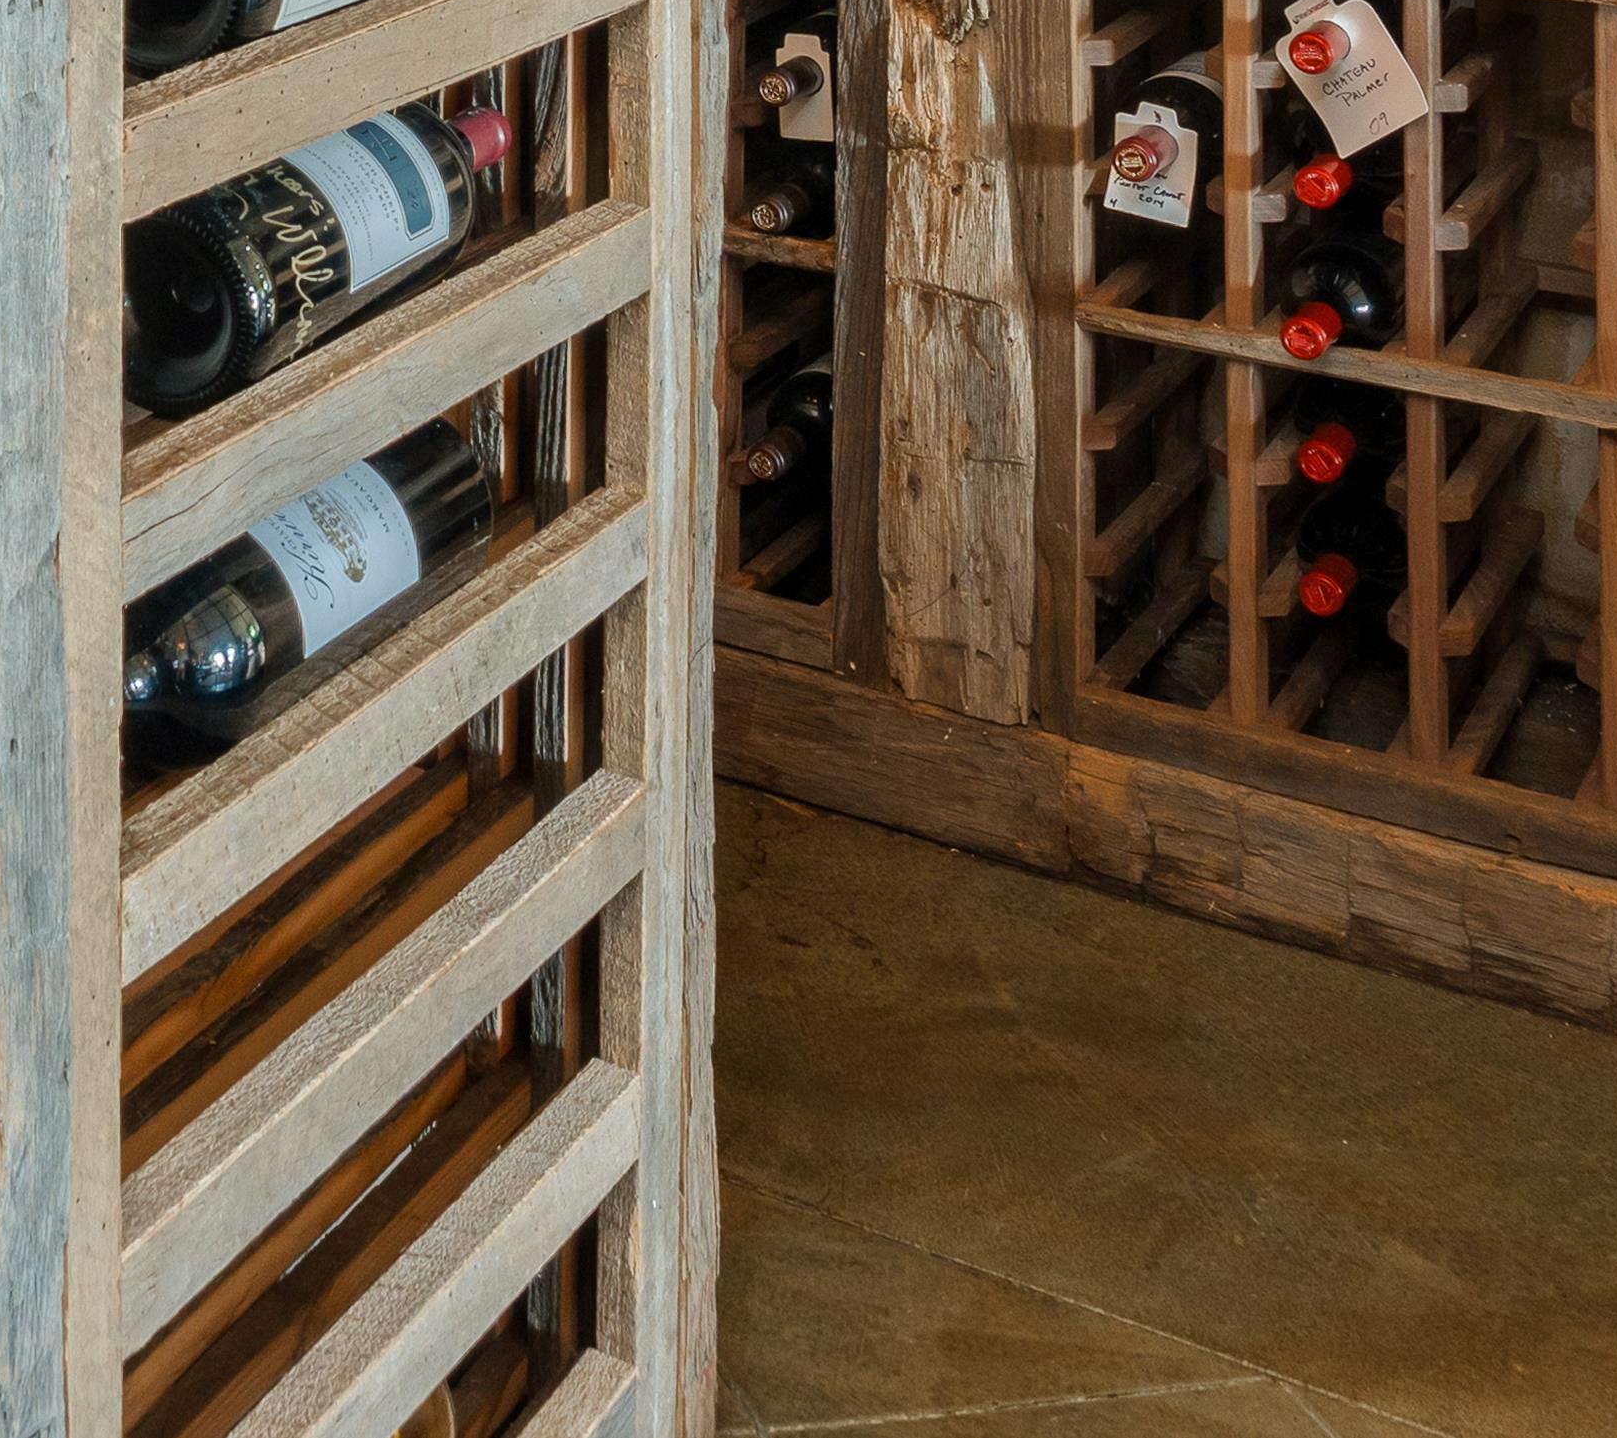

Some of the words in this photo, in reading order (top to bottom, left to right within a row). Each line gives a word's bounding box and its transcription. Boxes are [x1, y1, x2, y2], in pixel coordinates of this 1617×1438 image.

[1322, 59, 1376, 96] CHATEAU
[1369, 111, 1390, 136] 09
[266, 165, 336, 232] heers:
